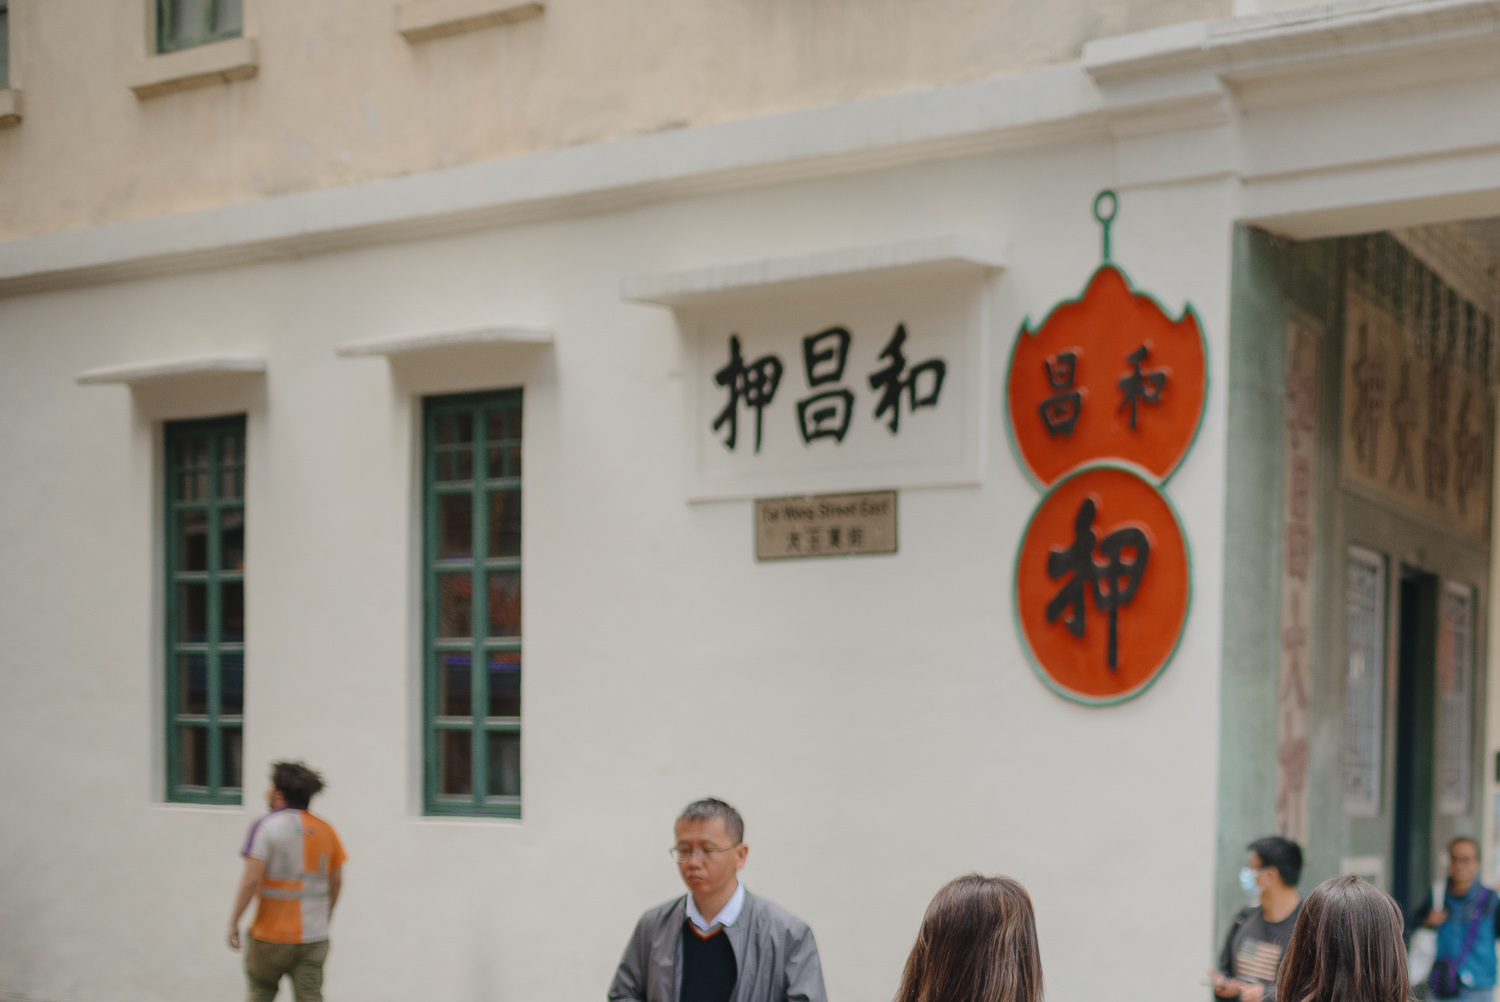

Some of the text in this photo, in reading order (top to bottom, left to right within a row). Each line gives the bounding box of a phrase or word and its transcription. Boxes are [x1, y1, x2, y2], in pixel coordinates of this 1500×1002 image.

[818, 501, 857, 519] Street
[859, 498, 889, 517] East
[1046, 496, 1150, 672] 押
